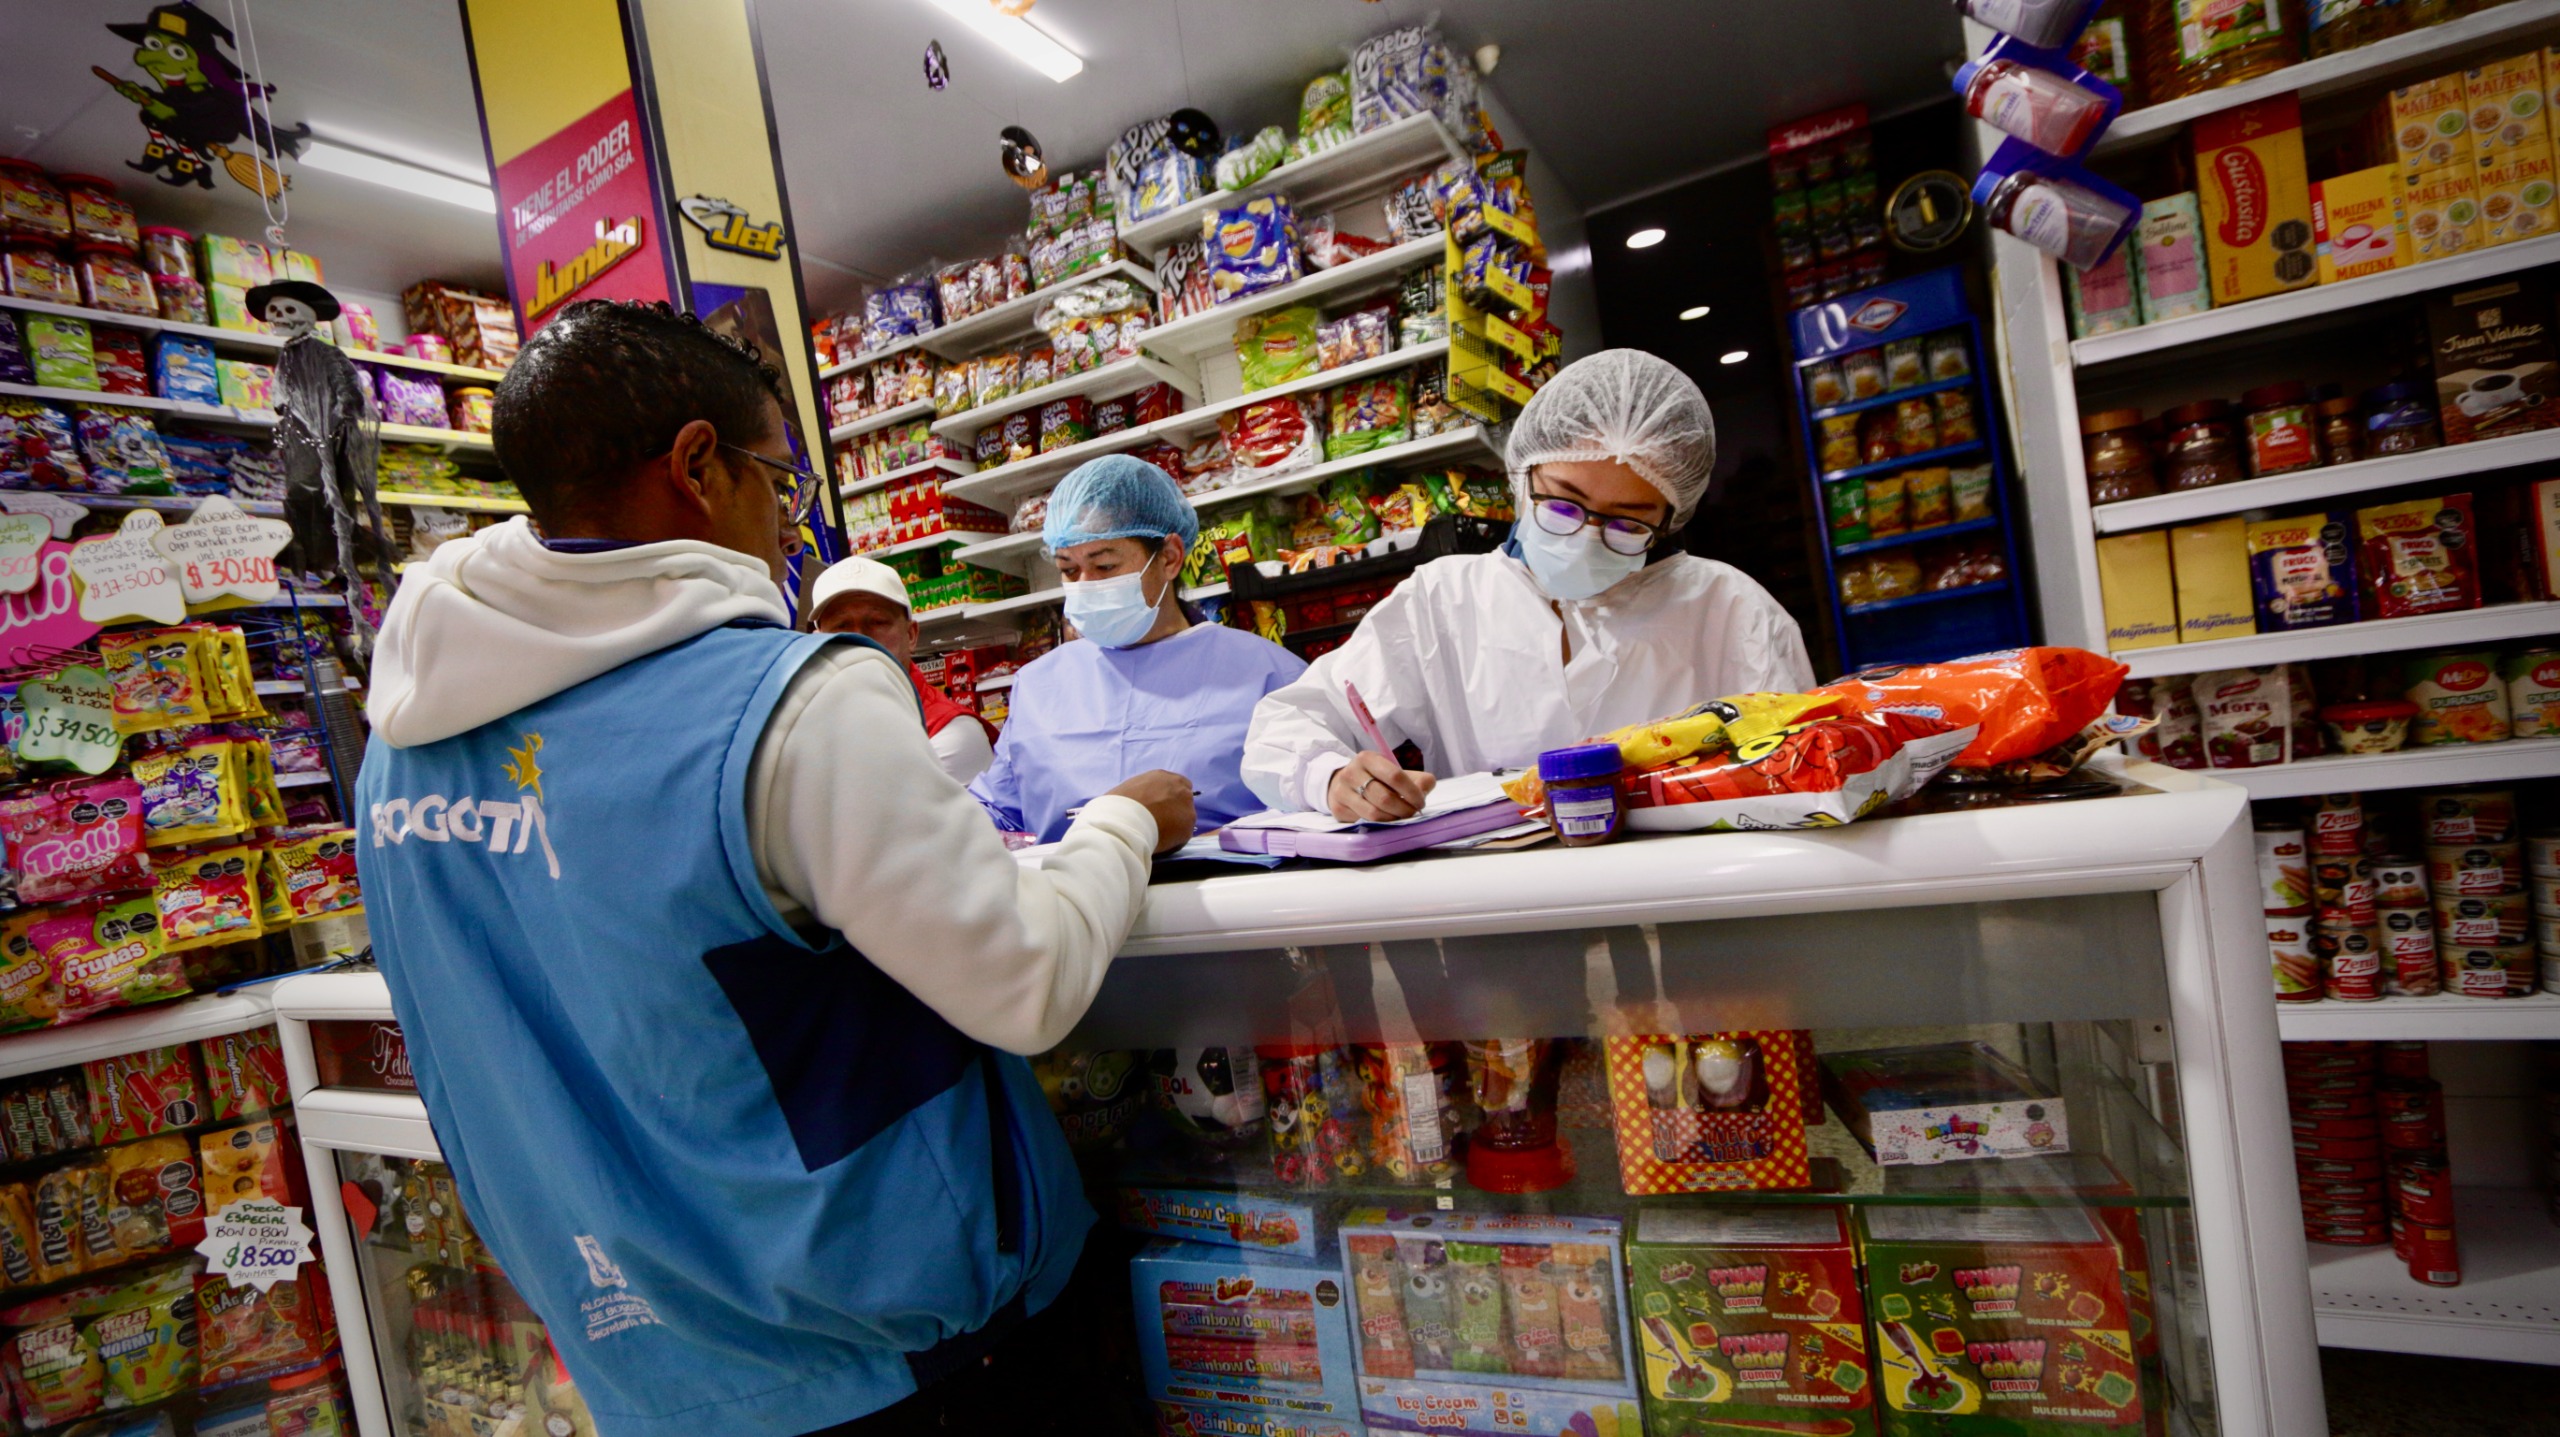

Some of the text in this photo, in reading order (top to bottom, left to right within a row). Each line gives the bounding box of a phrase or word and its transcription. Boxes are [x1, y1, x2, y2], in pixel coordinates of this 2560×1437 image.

[1355, 26, 1425, 81] Cheetos
[2468, 68, 2538, 97] MAIZENA
[2395, 88, 2463, 118] MAIZENA
[512, 119, 631, 231] TIENE EL PODER
[2479, 158, 2551, 187] MAIZENA
[2222, 151, 2254, 243] Gustosita
[2407, 177, 2474, 204] MAIZENA
[515, 228, 528, 249] DE
[528, 187, 585, 236] DISFRUTARSE
[586, 164, 614, 195] COMO
[2331, 197, 2386, 221] MAIZENA
[708, 211, 786, 260] Jet
[525, 215, 642, 322] Jumbo
[2335, 256, 2396, 282] MAIZENA
[2440, 334, 2486, 354] Juan
[2485, 322, 2545, 344] Valdez
[186, 556, 278, 590] $ 30.500
[2282, 555, 2318, 569] FRUCO
[90, 566, 167, 601] $ 17.500
[2208, 700, 2272, 718] Mora
[23, 818, 121, 878] Trolli
[64, 850, 119, 875] FRESAS
[2348, 880, 2374, 902] Zen
[65, 940, 148, 984] Frunas
[1941, 1132, 1976, 1144] CANDY
[1151, 1197, 1213, 1221] Rainbow
[1214, 1205, 1264, 1232] Candy
[215, 1226, 290, 1240] BON O BON
[222, 1240, 298, 1269] $ 8.500
[233, 1268, 278, 1281] ANIMATE
[588, 1310, 605, 1323] DE
[1180, 1310, 1242, 1328] Rainbow
[1243, 1311, 1290, 1334] Candy
[1182, 1357, 1292, 1377] Rainbow Candy
[1286, 1399, 1335, 1413] CANDY
[1396, 1395, 1479, 1411] Ice Cream
[1193, 1412, 1316, 1437] Rainbow Candy
[1416, 1409, 1468, 1429] Candy
